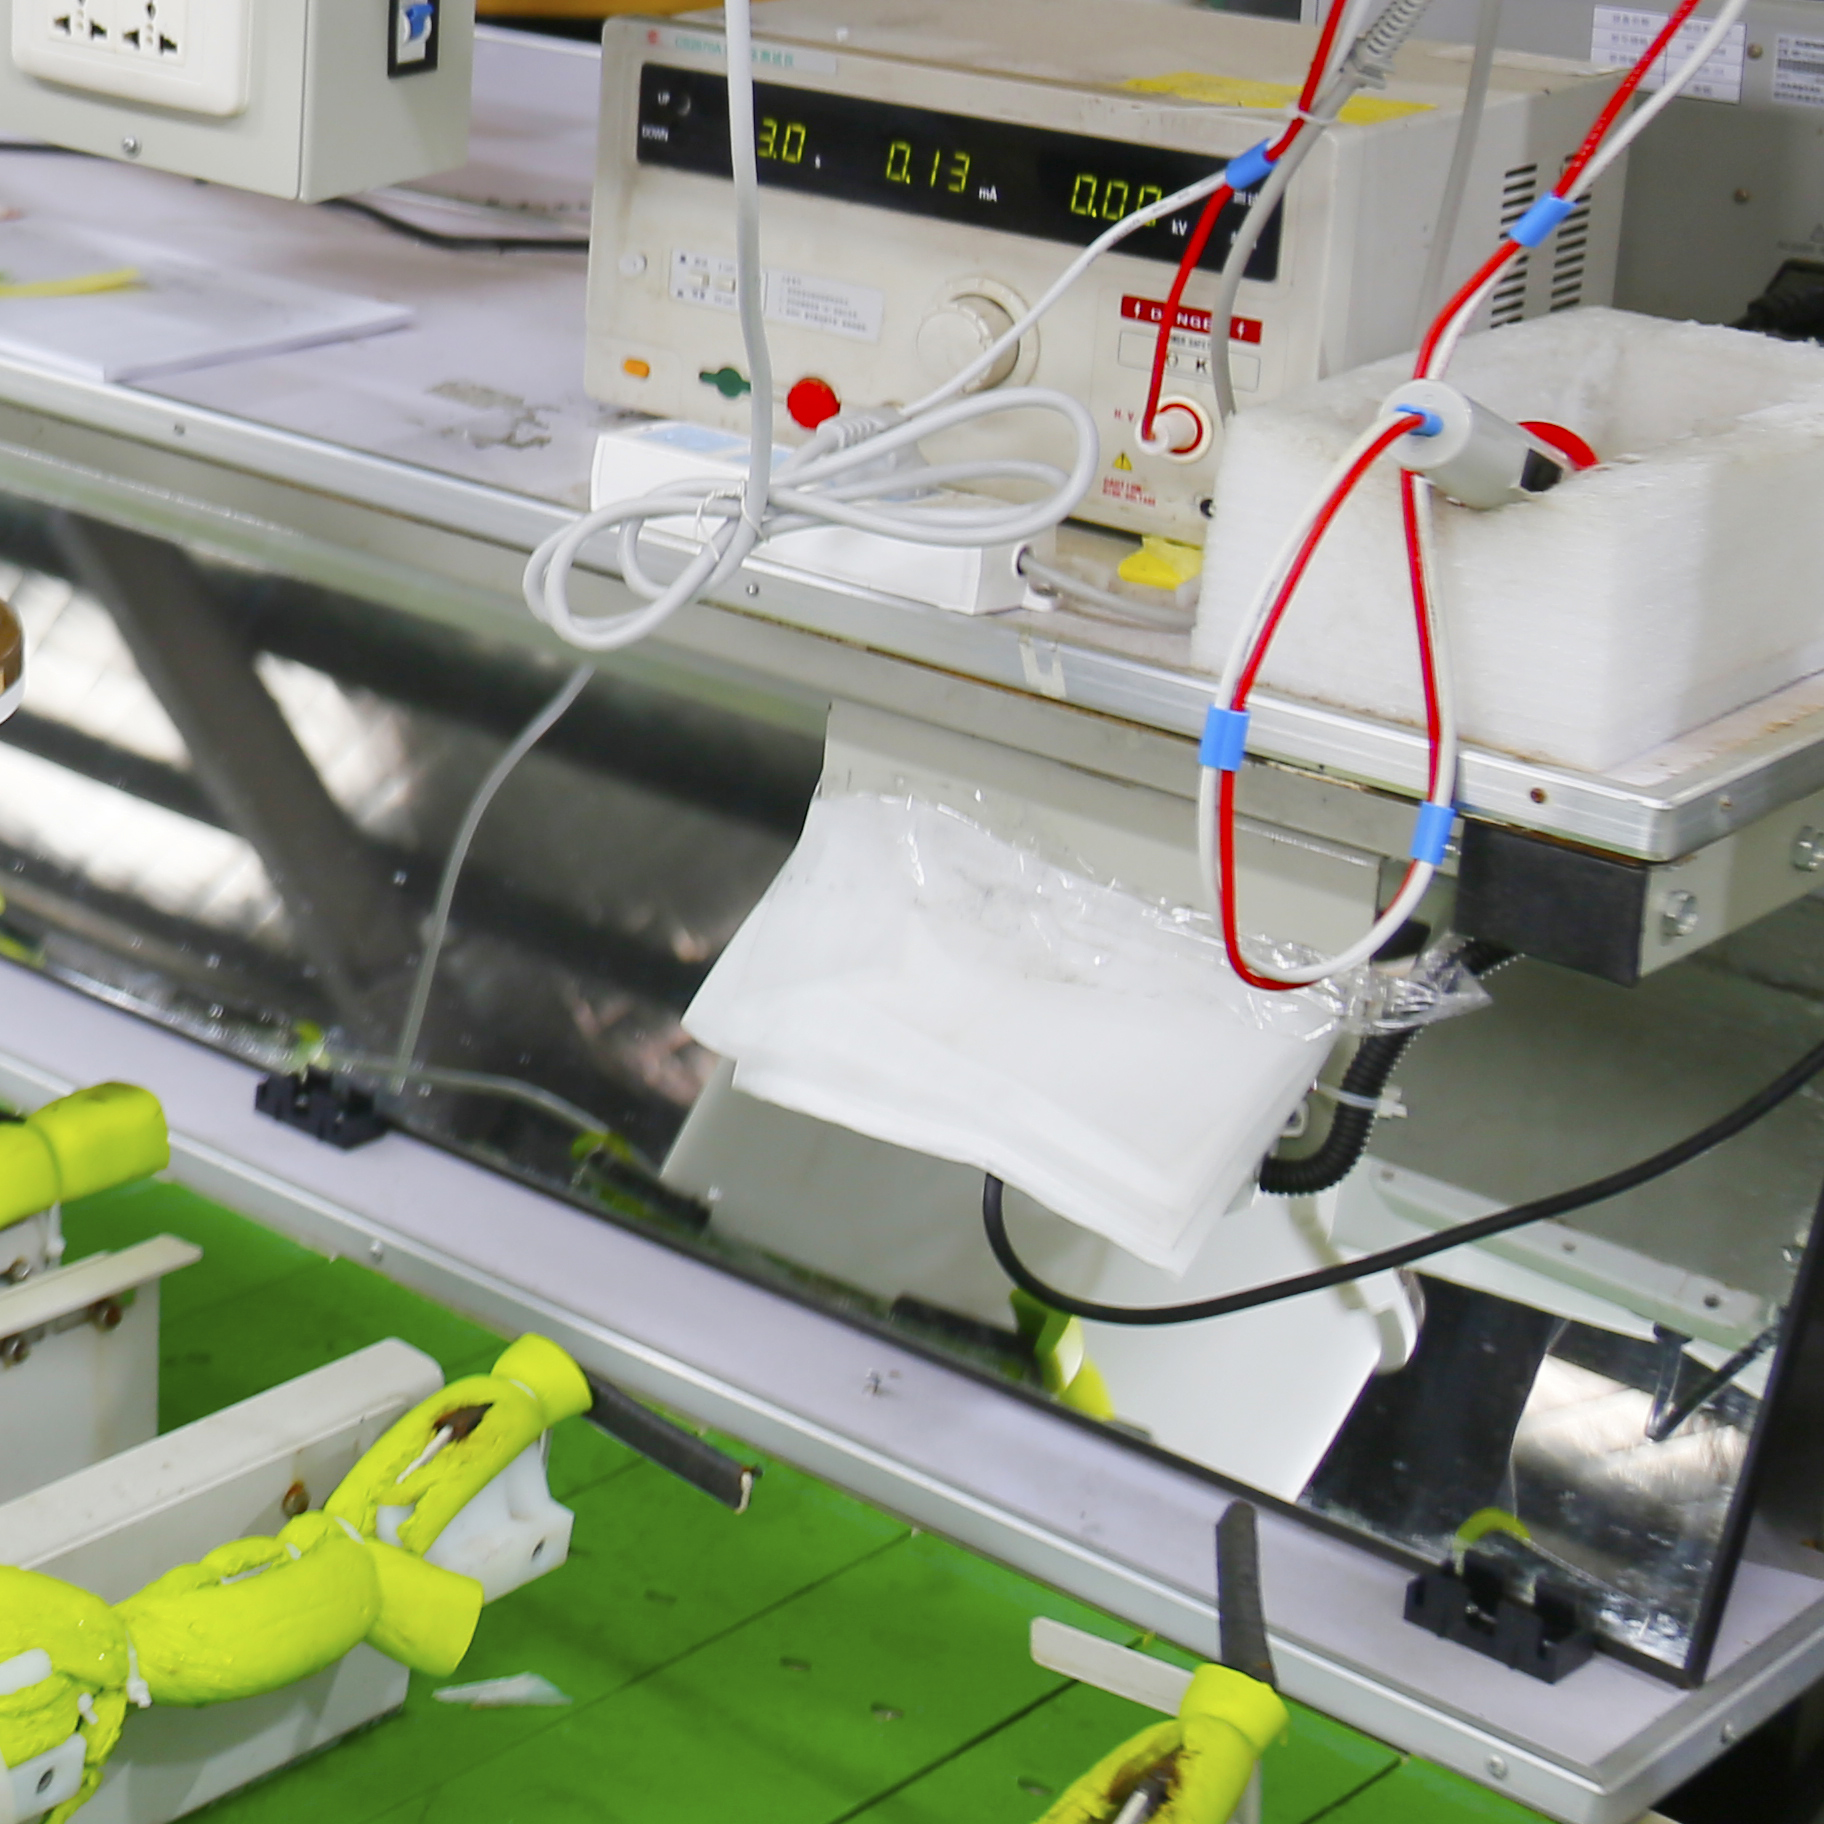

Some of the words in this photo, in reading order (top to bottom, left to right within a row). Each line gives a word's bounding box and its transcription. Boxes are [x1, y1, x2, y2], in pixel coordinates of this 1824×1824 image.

[657, 91, 670, 106] UP
[642, 124, 669, 143] DOWN
[886, 141, 971, 194] 0.13
[979, 185, 999, 203] mA
[1171, 218, 1188, 237] kV
[1151, 306, 1213, 332] DNGE
